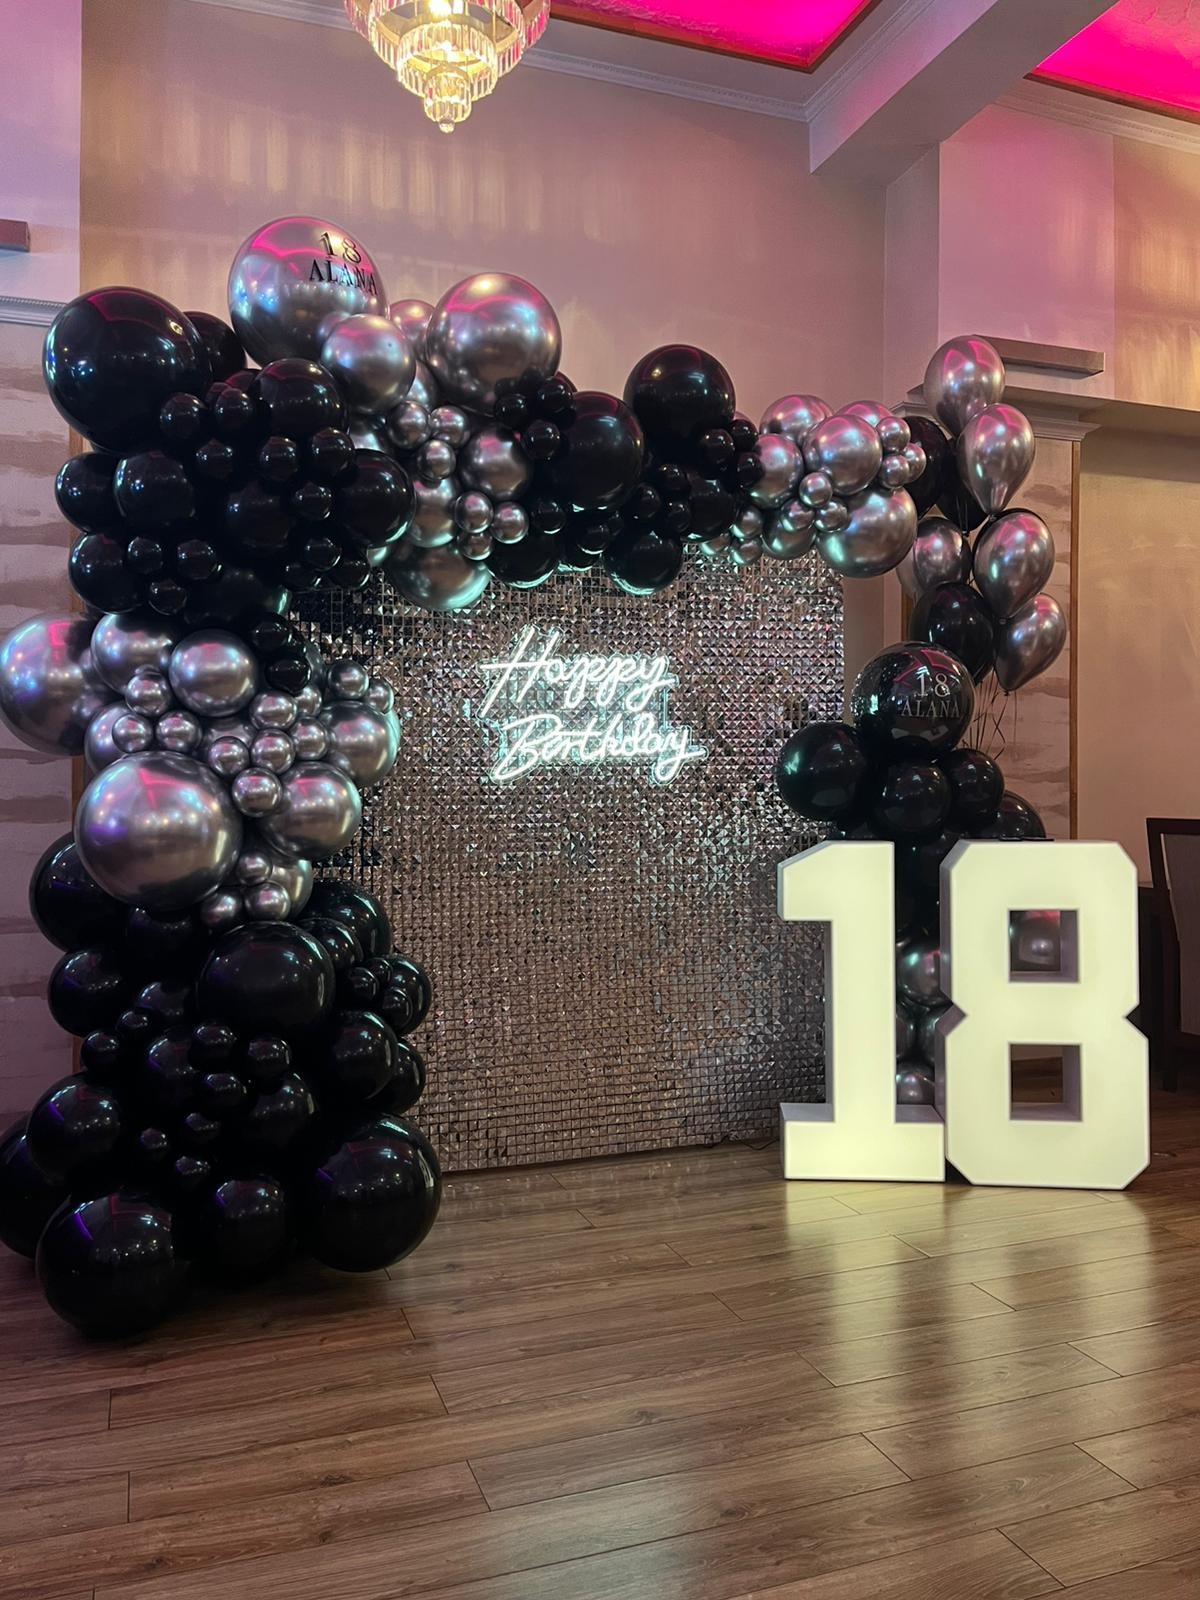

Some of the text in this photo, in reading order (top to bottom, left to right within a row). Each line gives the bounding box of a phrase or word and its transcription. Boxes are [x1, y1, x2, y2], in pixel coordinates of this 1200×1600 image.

[320, 231, 362, 264] 18
[309, 259, 377, 296] ALANA
[477, 626, 676, 712] Happy
[914, 672, 951, 698] 18
[901, 698, 960, 718] ALANA
[494, 712, 707, 782] Birthday
[778, 840, 1150, 1190] 18
